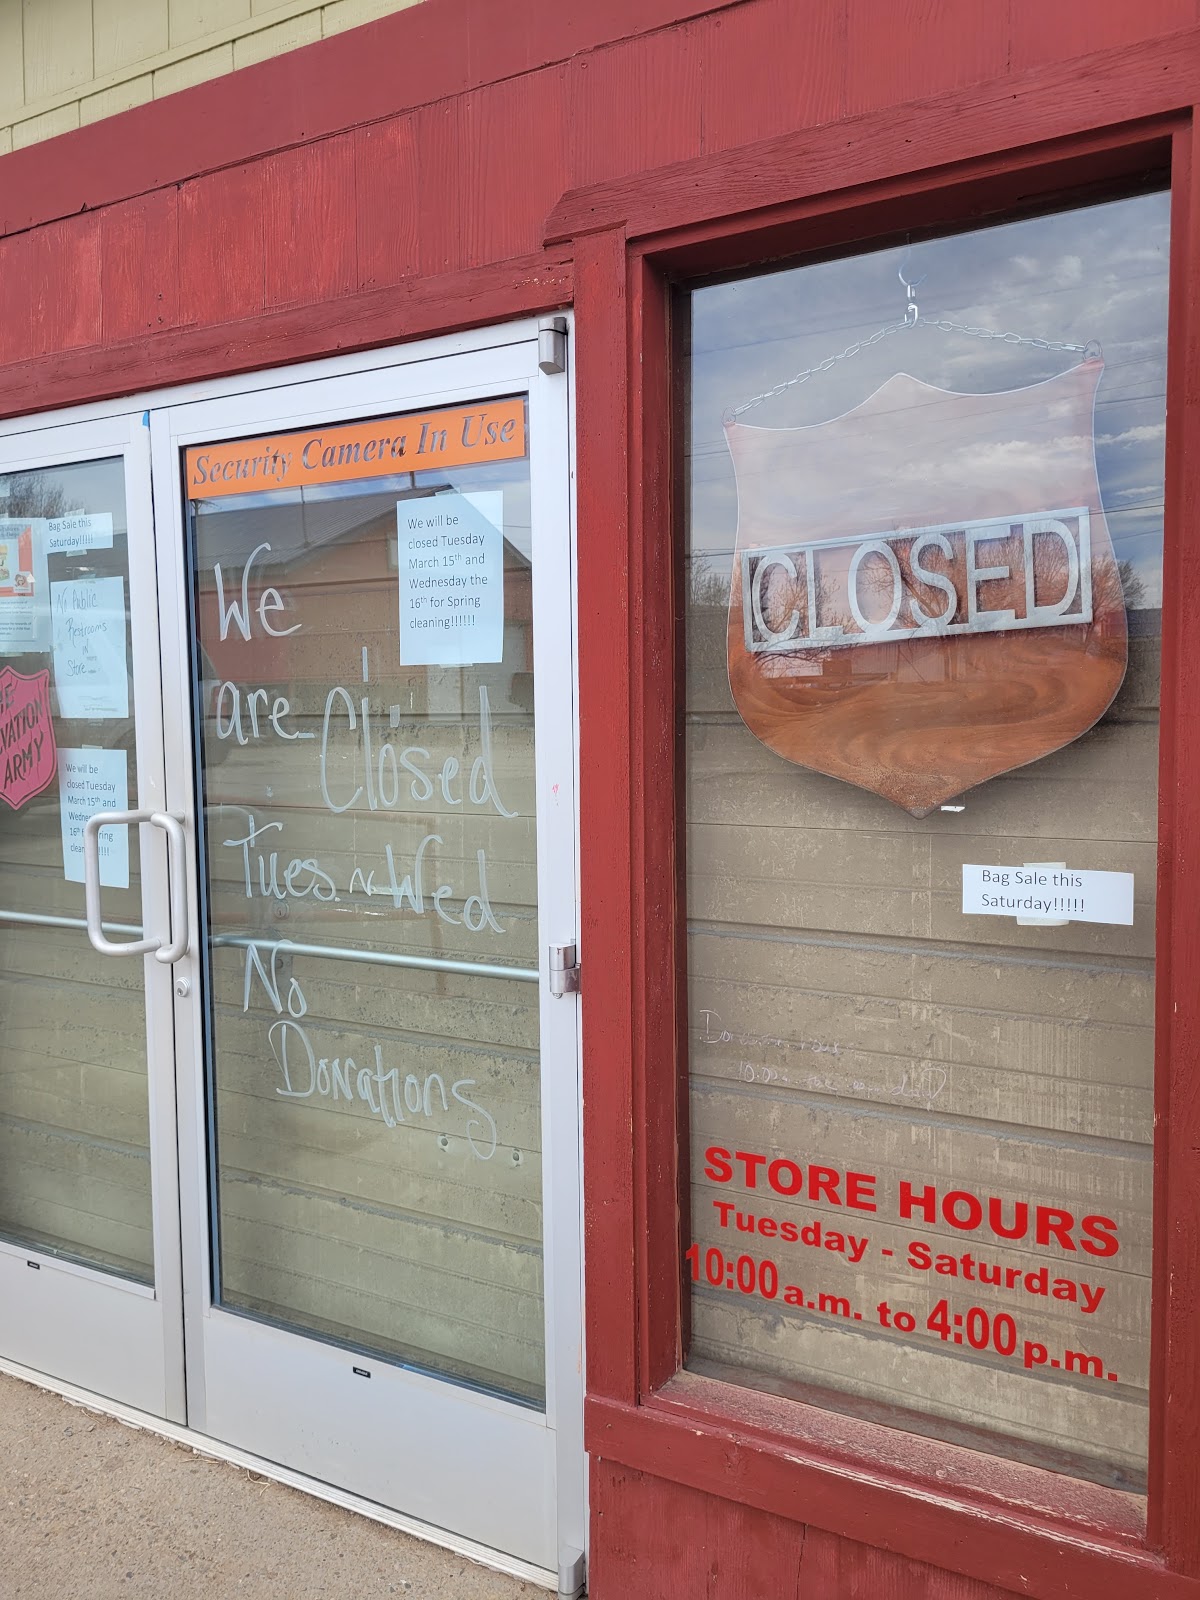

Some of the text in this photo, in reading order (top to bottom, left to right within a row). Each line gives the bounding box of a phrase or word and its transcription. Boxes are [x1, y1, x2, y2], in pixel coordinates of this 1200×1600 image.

[193, 413, 516, 486] Security Camera In Use
[48, 517, 92, 533] Bag Sale this
[407, 514, 459, 530] We will be
[408, 533, 485, 550] closed Tuesday
[409, 553, 485, 570] March 15th and
[213, 542, 302, 641] We
[409, 574, 488, 589] Wednesday the
[751, 518, 1080, 643] CLOSED
[72, 588, 98, 611] Public
[410, 595, 481, 609] 16th for Spring
[65, 617, 108, 648] Restrooms
[0, 698, 43, 755] VATION
[321, 646, 518, 818] Closed
[4, 730, 44, 790] ARMY
[65, 763, 76, 773] We
[89, 763, 98, 774] be
[67, 779, 116, 793] closed Tuesday
[67, 795, 116, 808] March 15th and
[386, 834, 507, 934] Wed
[982, 869, 1083, 887] Bag Sale this
[981, 893, 1085, 913] Saturday!!!!!
[243, 939, 308, 1019] No
[703, 1146, 1120, 1257] STORE HOURS
[712, 1200, 1106, 1314] Tuesday - Saturday
[876, 1301, 916, 1332] to
